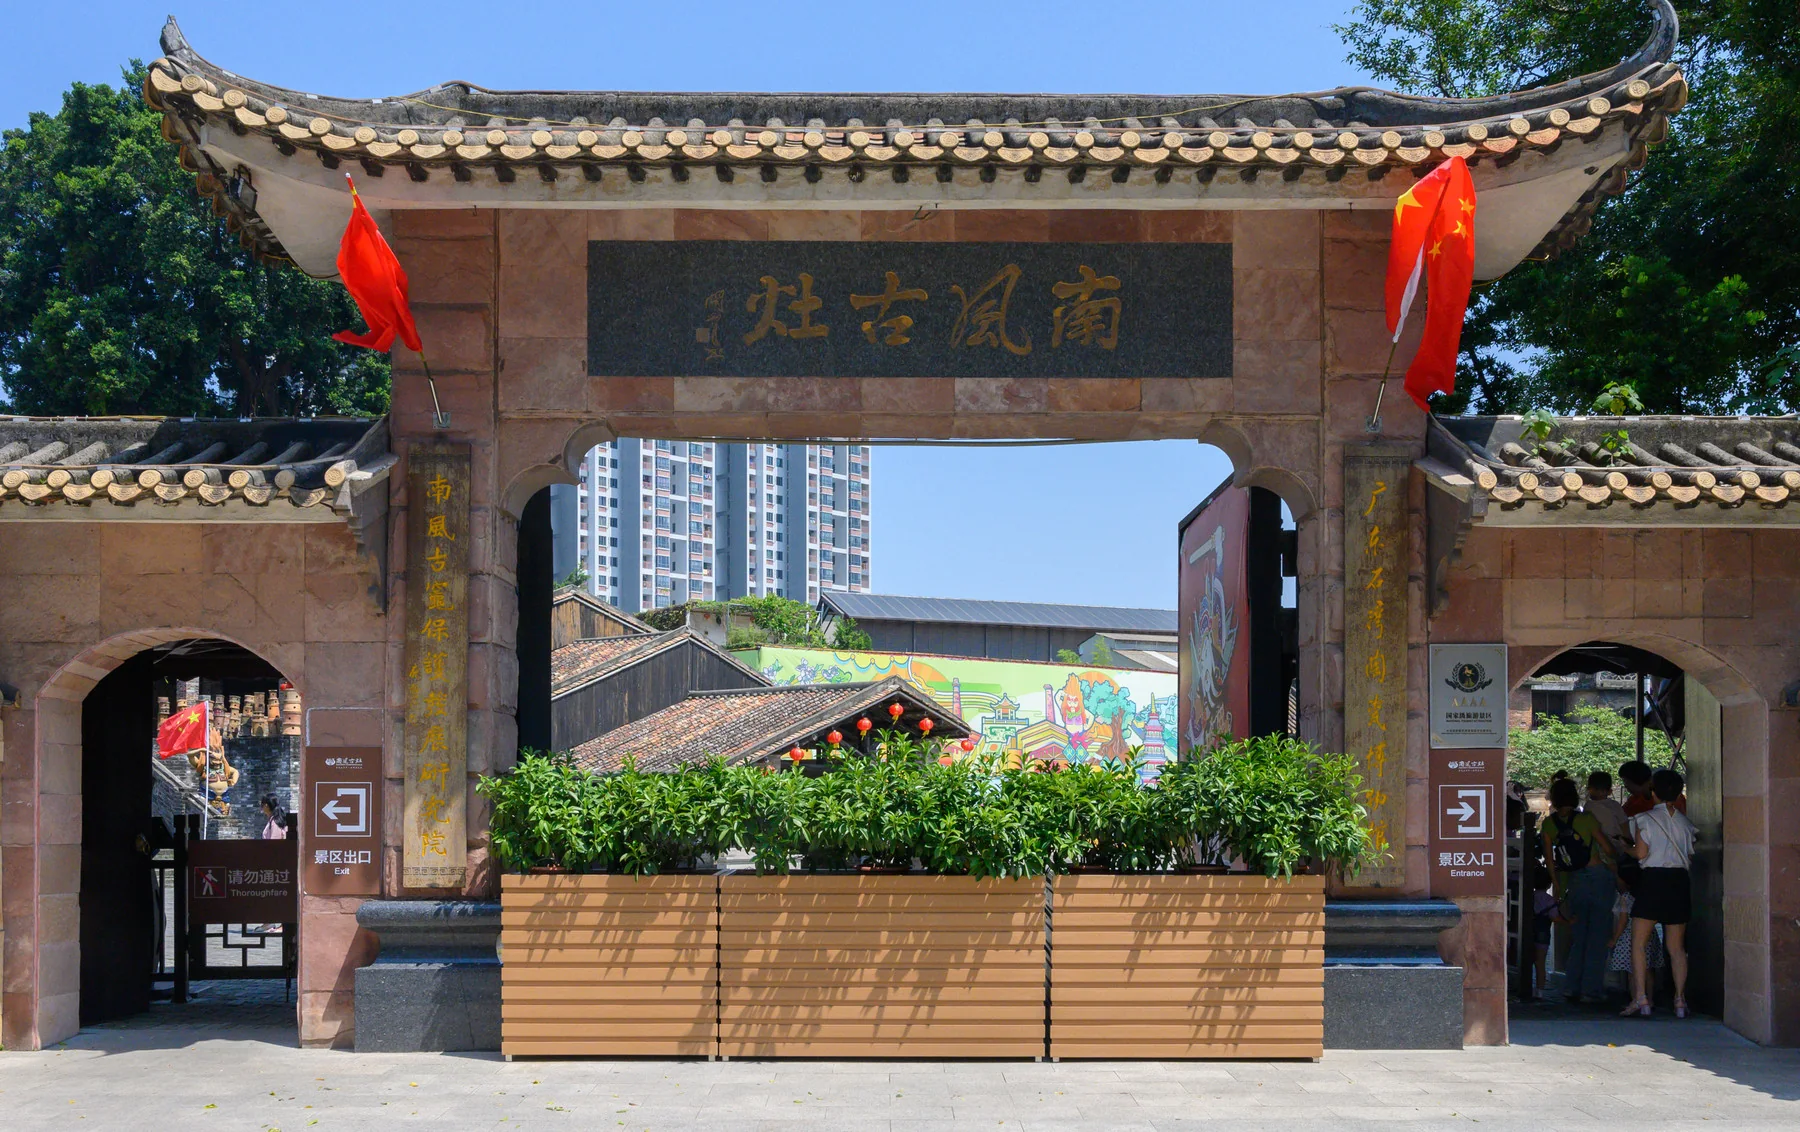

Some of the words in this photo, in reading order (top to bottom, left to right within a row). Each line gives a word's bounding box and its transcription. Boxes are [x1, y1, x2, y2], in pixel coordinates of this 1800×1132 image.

[315, 850, 371, 864] 景区出口
[1439, 852, 1494, 866] 景区入口
[228, 869, 290, 884] 请勿通过
[334, 867, 350, 875] Exit
[232, 889, 287, 898] Thoroughfare
